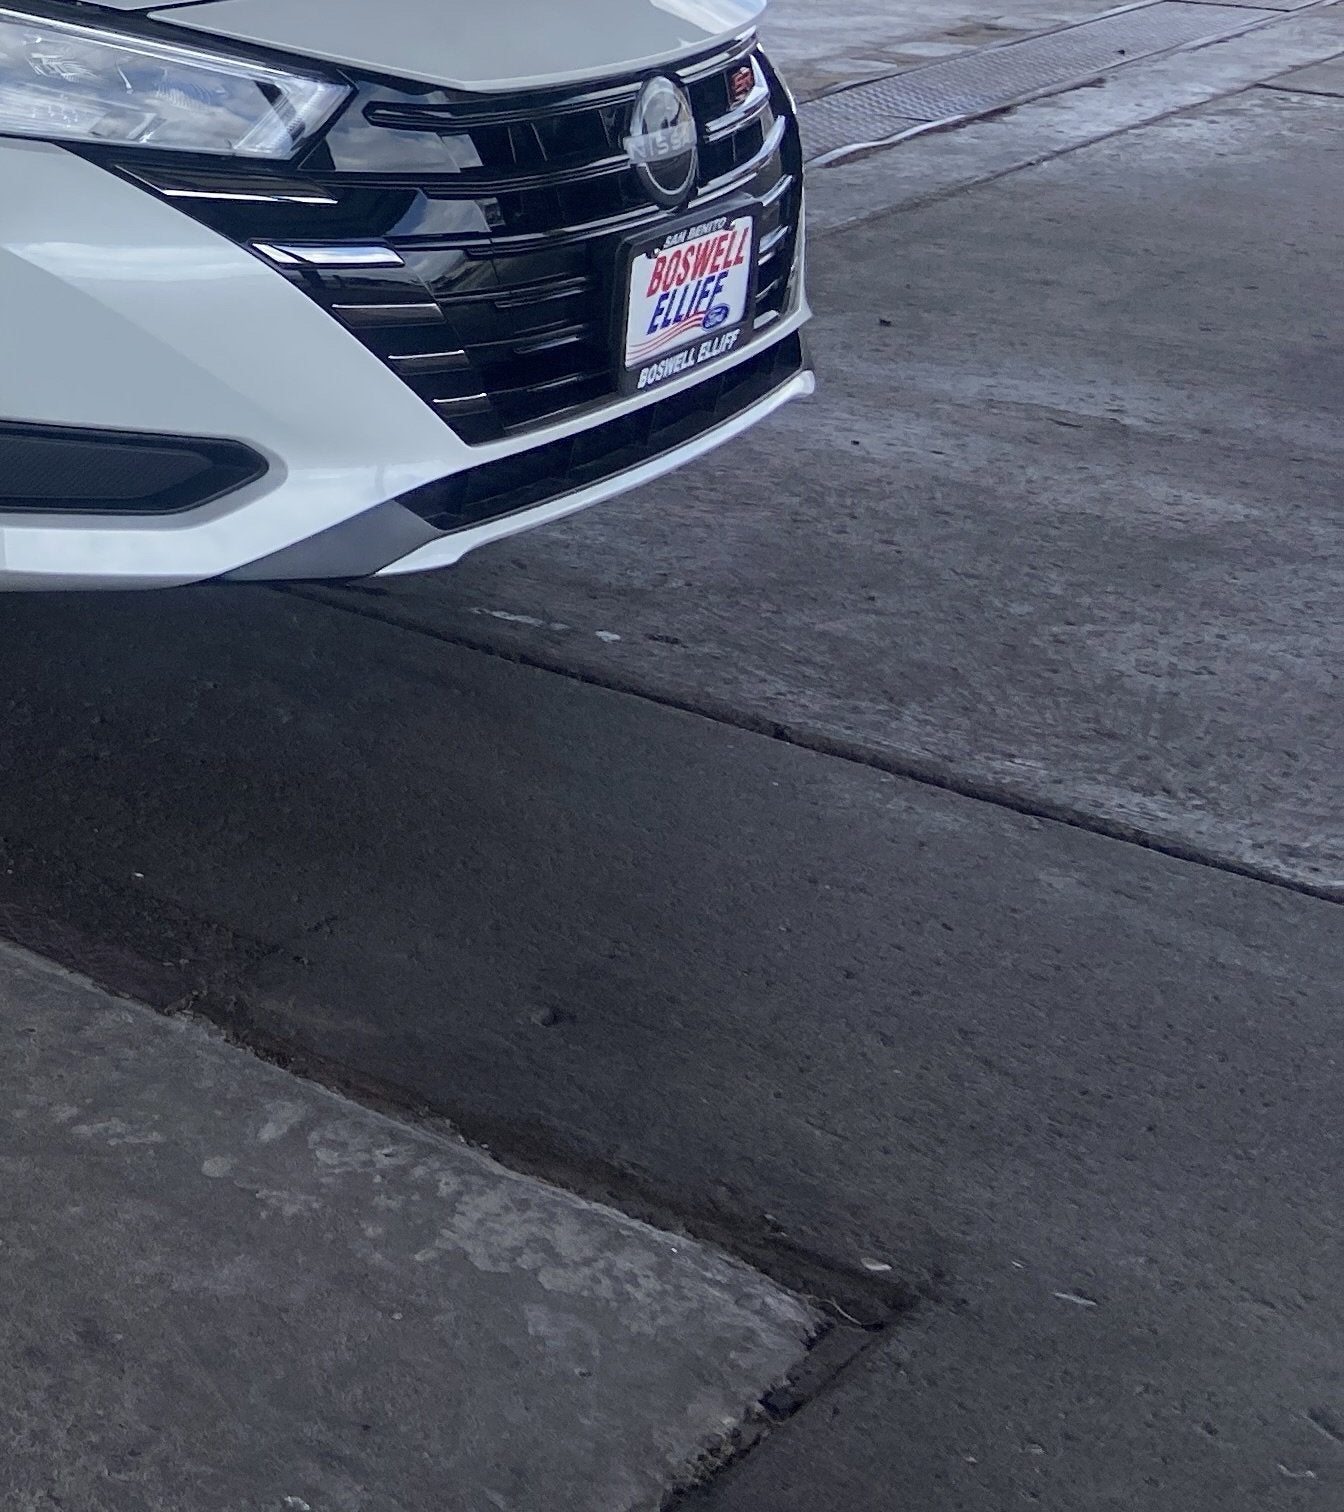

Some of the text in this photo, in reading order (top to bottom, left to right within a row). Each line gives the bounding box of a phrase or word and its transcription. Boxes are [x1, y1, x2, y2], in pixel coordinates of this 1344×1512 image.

[646, 227, 749, 298] BOSWELL
[663, 229, 687, 248] SAN
[646, 270, 729, 335] ELLIFF
[637, 329, 741, 389] BOSWELL ELLIFF
